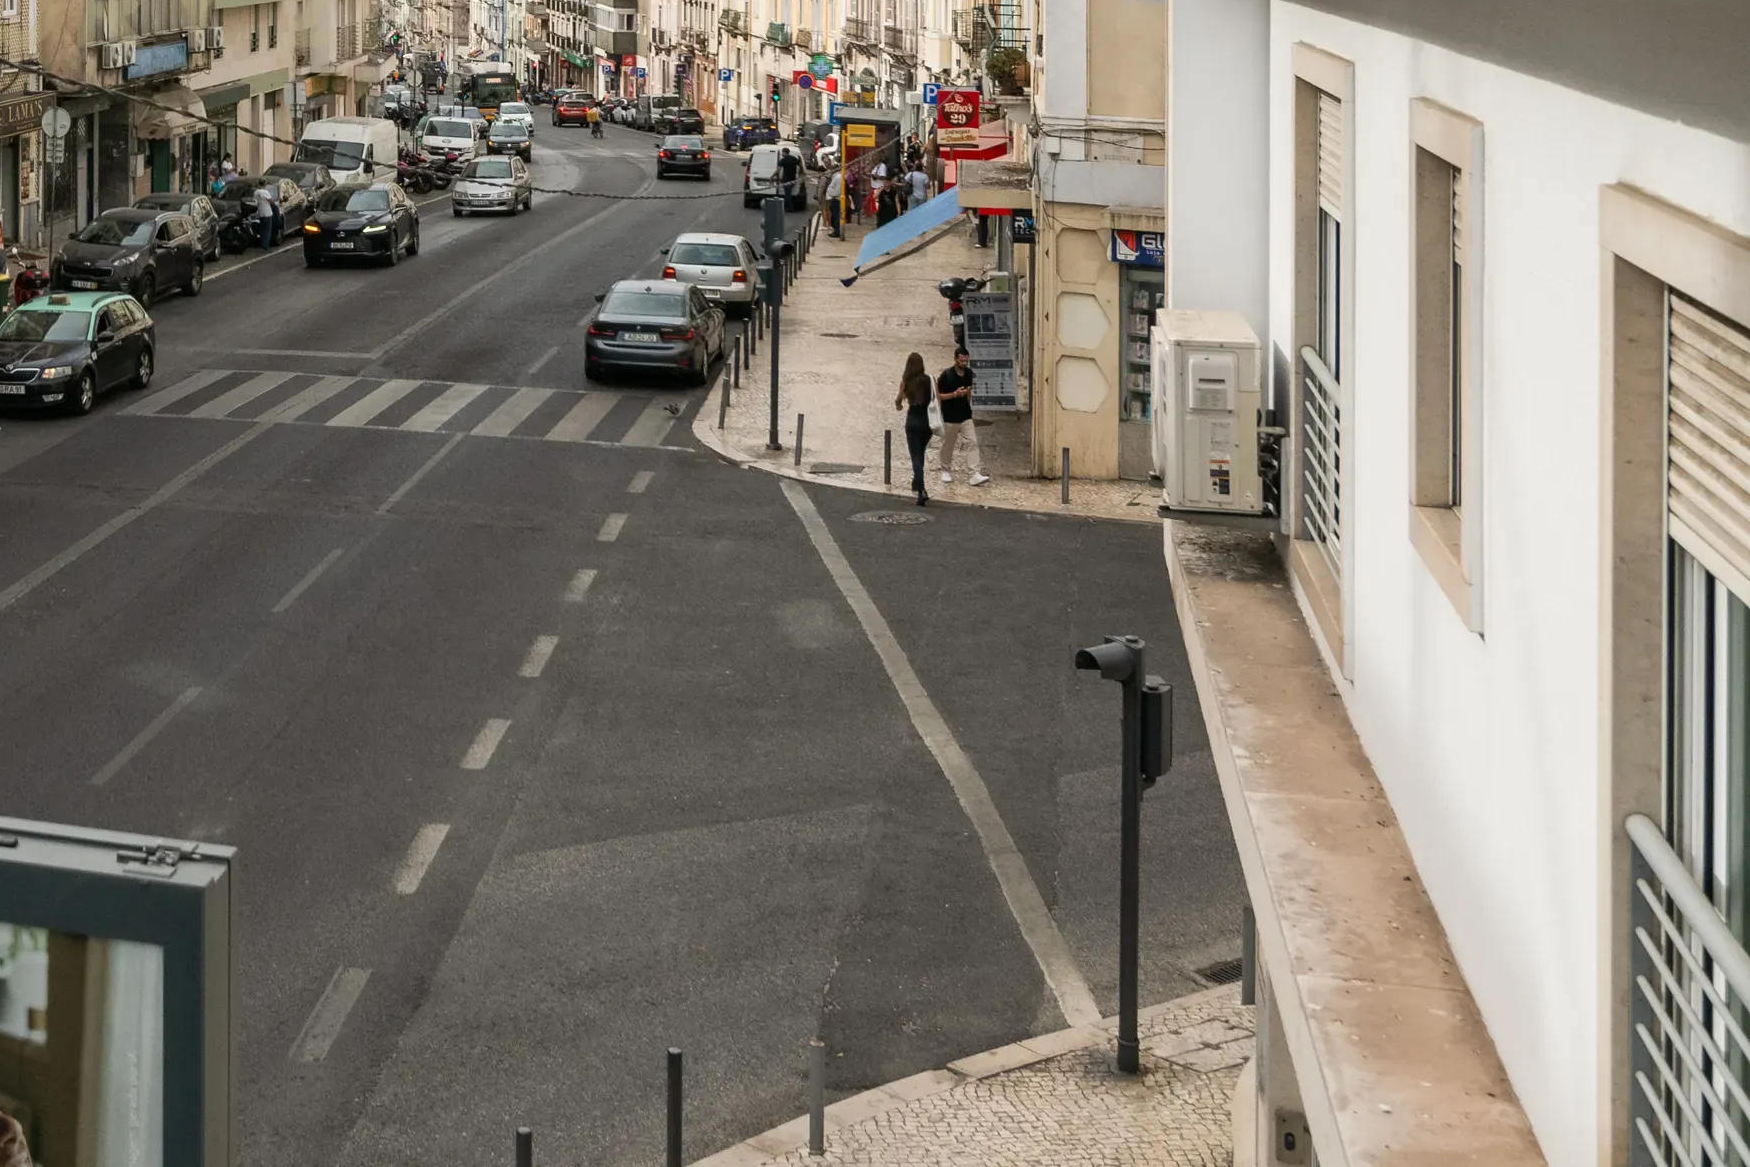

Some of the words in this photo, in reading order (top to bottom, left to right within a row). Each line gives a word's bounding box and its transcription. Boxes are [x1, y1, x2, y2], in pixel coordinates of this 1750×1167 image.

[638, 69, 644, 77] P
[721, 71, 729, 80] P
[926, 84, 938, 102] P
[8, 100, 43, 122] LAMA'S
[943, 102, 973, 113] Talho's
[950, 114, 967, 124] 29
